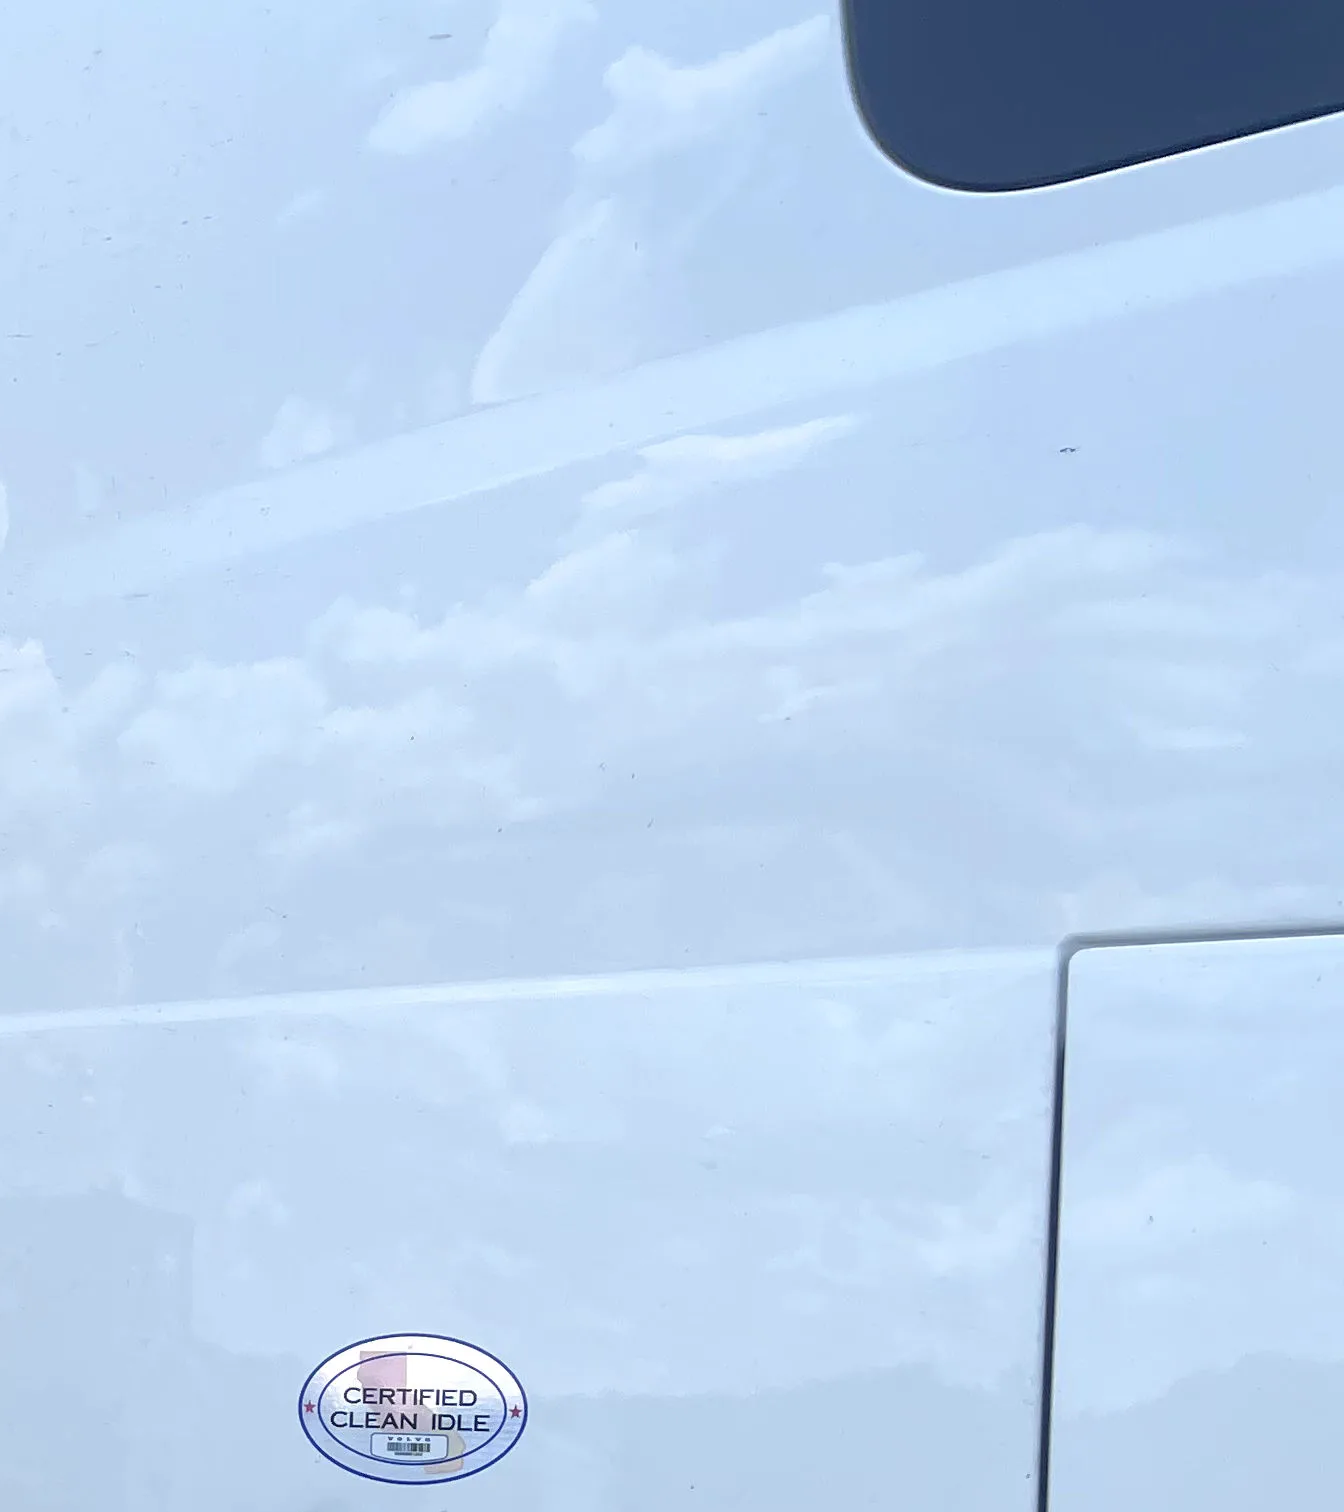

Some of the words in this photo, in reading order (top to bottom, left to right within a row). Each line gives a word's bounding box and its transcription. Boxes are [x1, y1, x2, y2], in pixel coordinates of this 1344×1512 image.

[343, 1387, 477, 1407] CERTIFIED
[330, 1411, 418, 1430] CLEAN
[431, 1413, 491, 1432] IDLE
